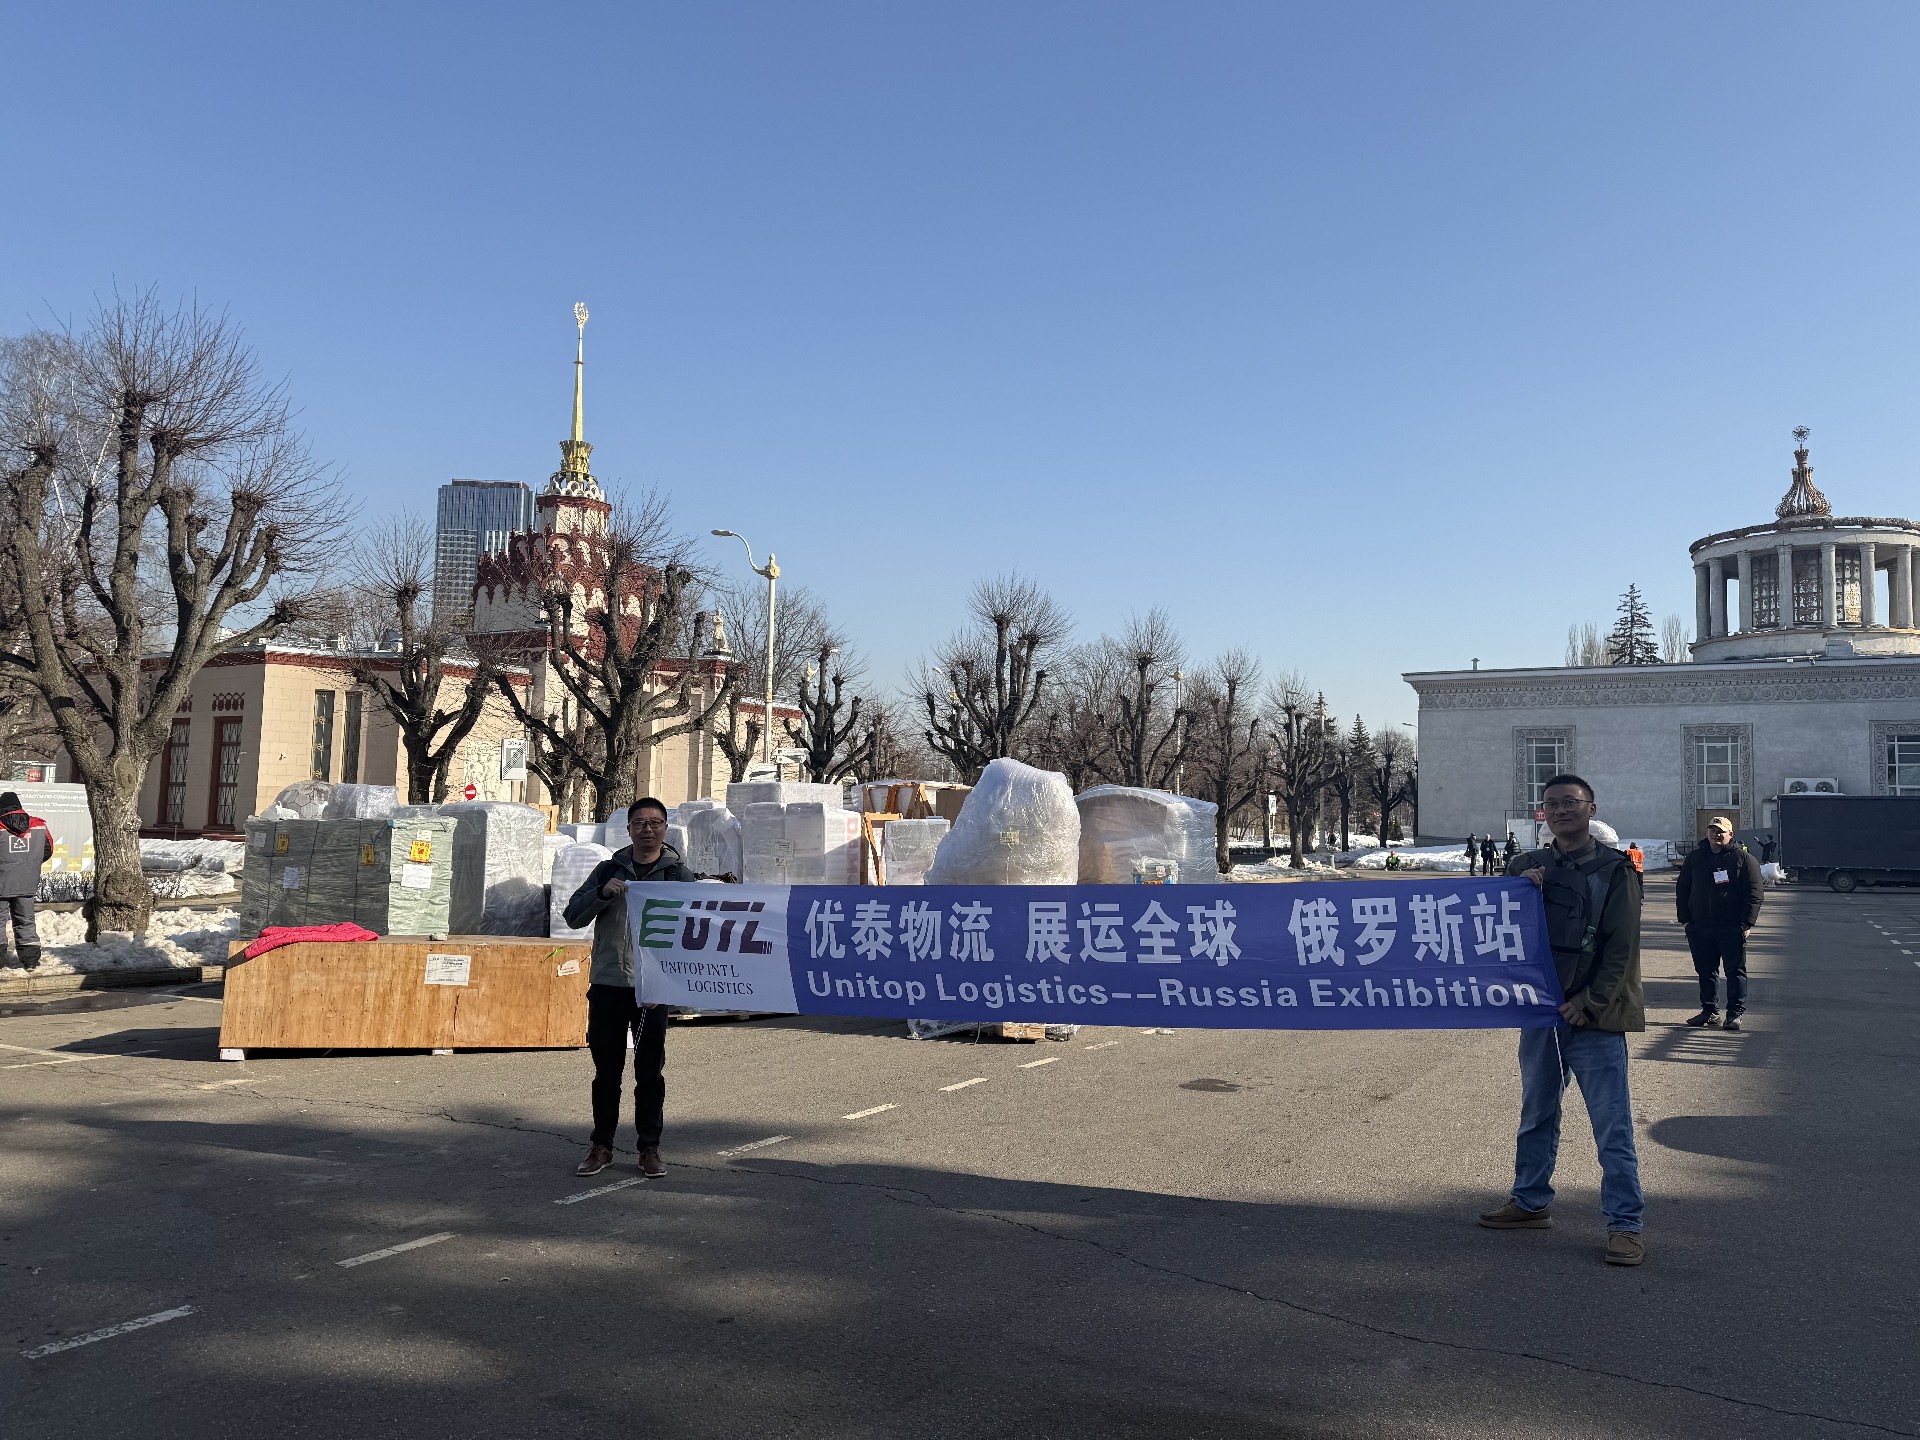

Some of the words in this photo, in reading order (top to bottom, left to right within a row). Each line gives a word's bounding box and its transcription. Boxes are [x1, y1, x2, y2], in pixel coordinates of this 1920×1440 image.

[803, 899, 994, 962] 优泰物流
[1025, 899, 1242, 967] 展运全球
[1287, 890, 1526, 966] 俄罗斯站
[660, 960, 705, 976] UNITOP
[687, 979, 754, 996] LOGISTICS
[807, 970, 926, 1005] Unitop
[1309, 976, 1540, 1007] Exhibition
